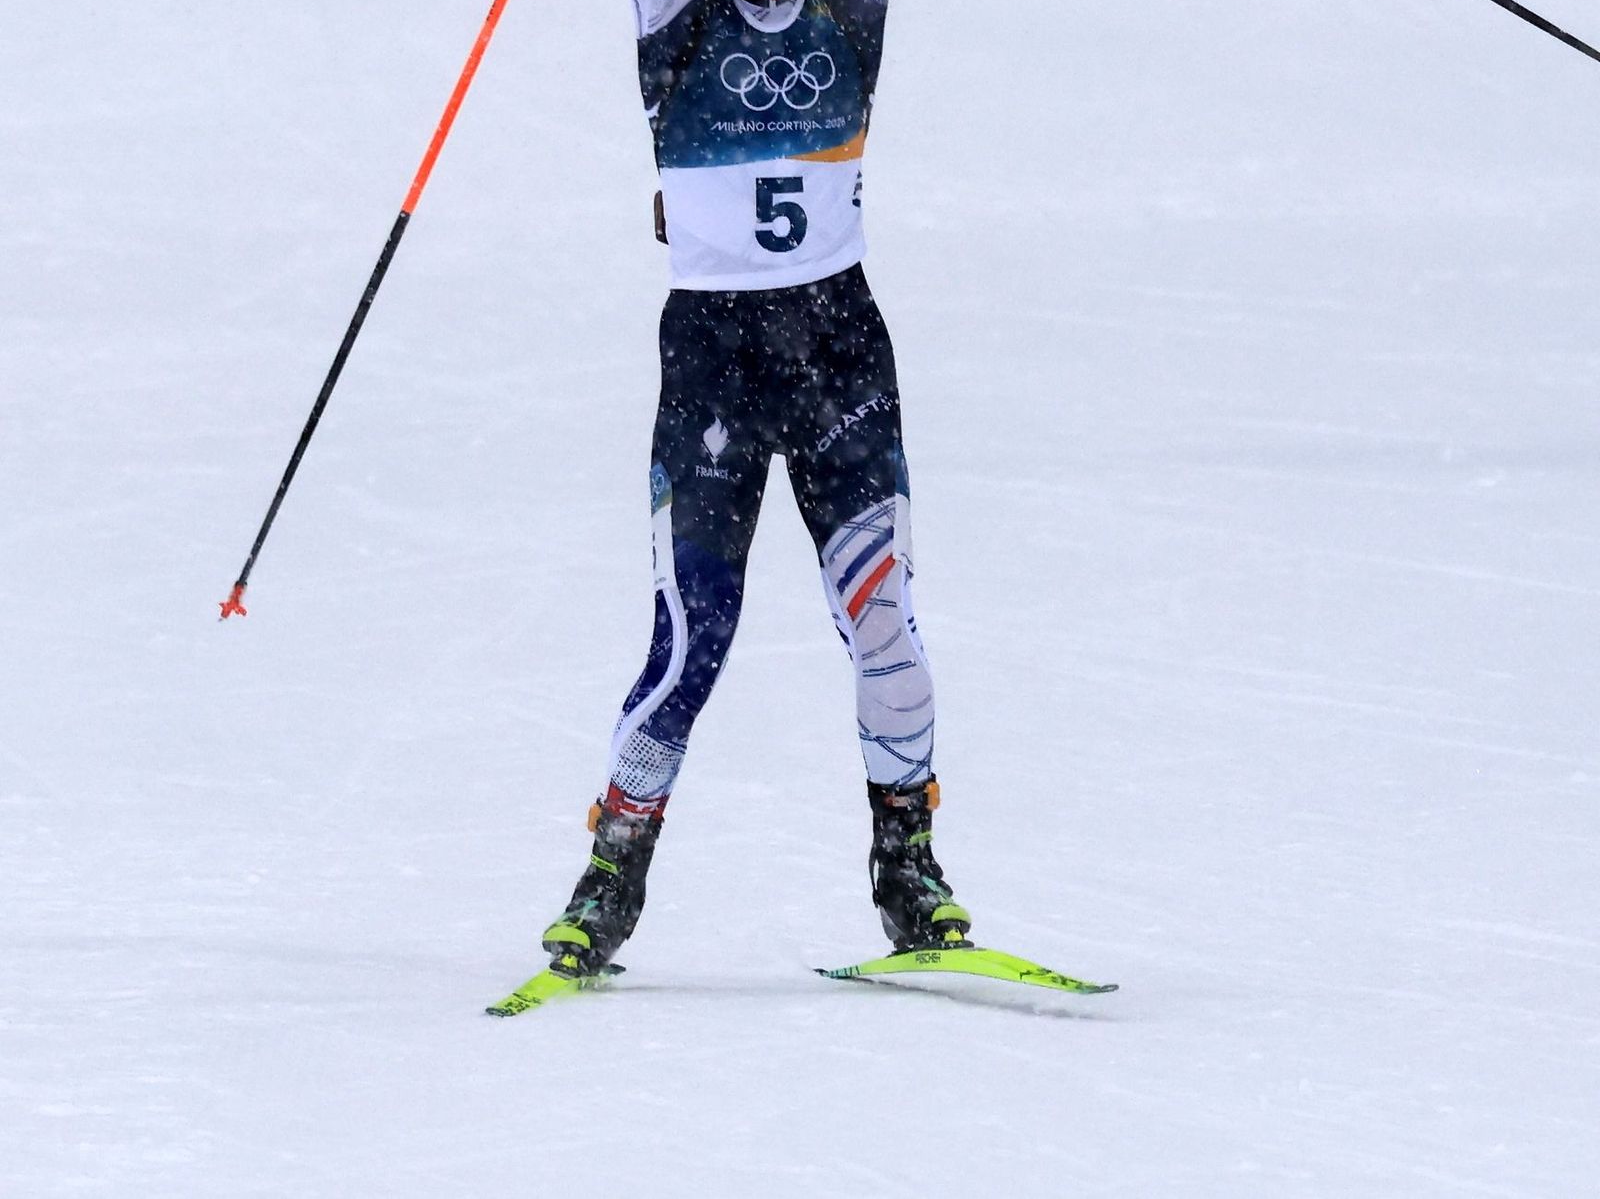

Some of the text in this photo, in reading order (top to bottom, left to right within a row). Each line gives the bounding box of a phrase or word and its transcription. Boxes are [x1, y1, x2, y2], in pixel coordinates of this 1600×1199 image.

[710, 120, 765, 132] MILANO
[767, 120, 822, 132] CORTINA
[755, 176, 808, 253] 5
[817, 397, 880, 453] CRAFT
[695, 465, 729, 480] FRANCE
